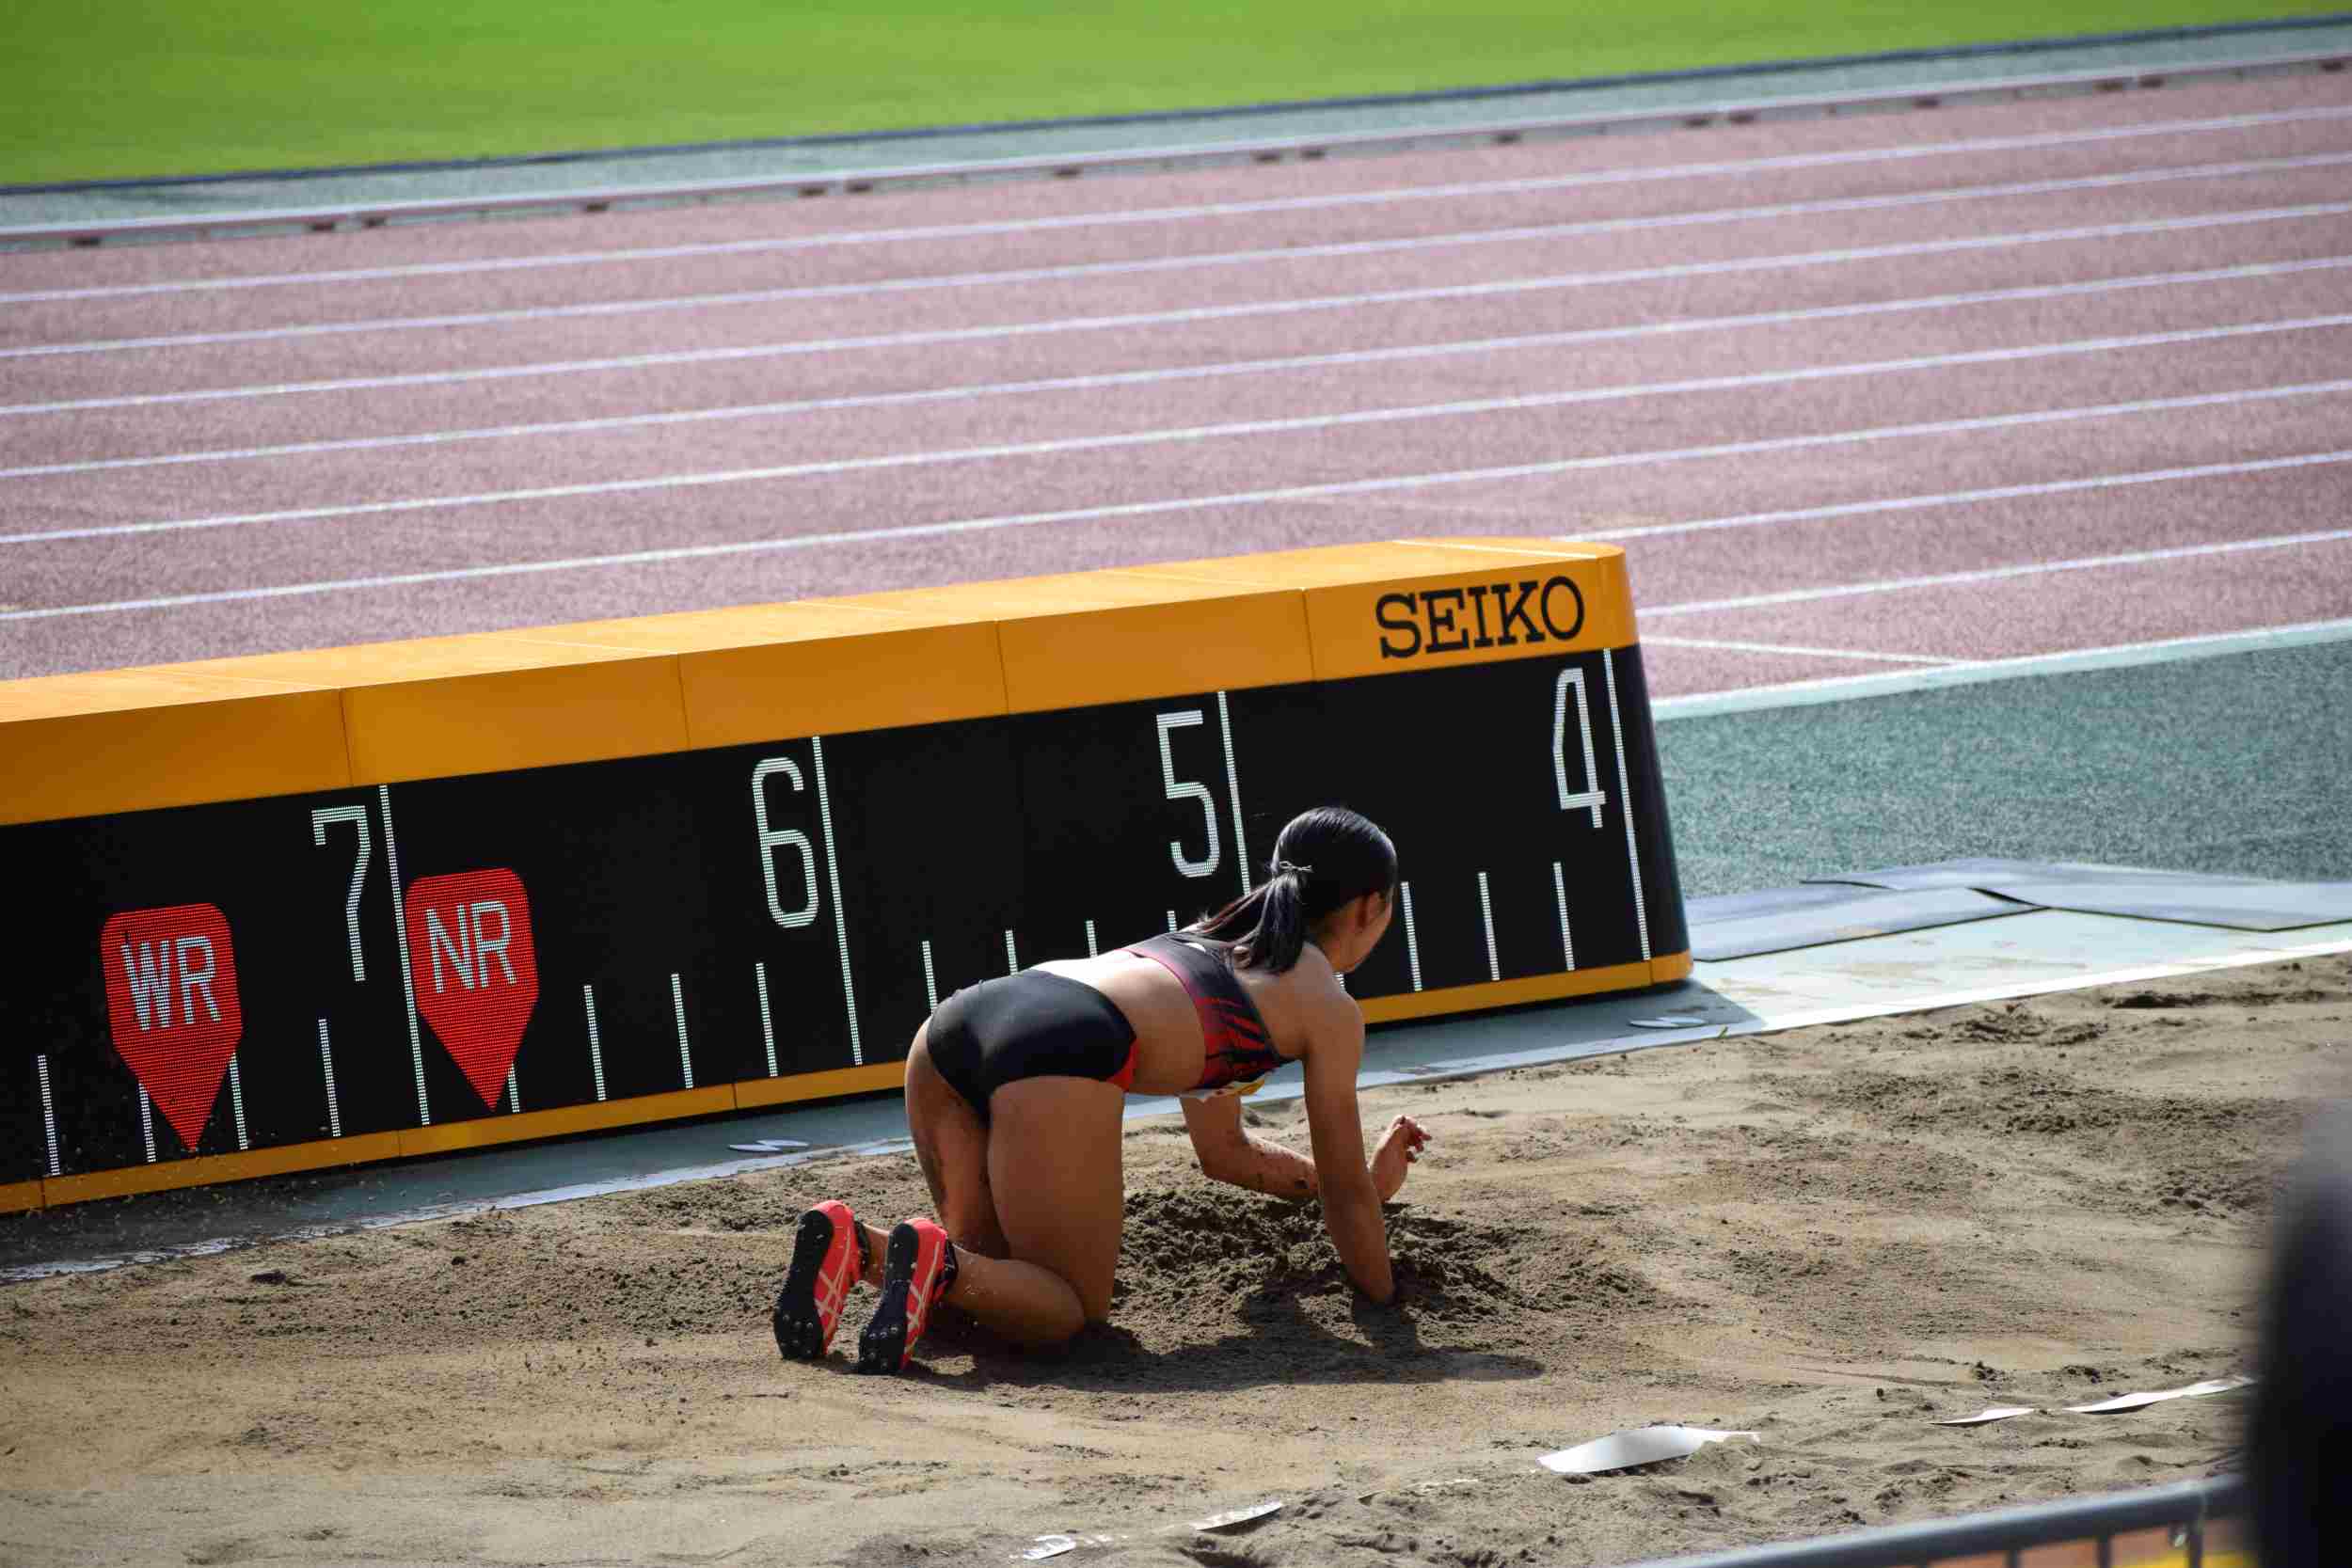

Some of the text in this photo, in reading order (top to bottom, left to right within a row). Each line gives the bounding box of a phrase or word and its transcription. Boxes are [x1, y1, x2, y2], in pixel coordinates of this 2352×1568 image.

[1375, 576, 1585, 659] SEIKO
[1156, 710, 1220, 878] 5
[1553, 667, 1605, 828] 4
[311, 805, 371, 982] 7
[752, 757, 818, 928] 6
[120, 936, 221, 1031] WR
[425, 900, 516, 993] NR
